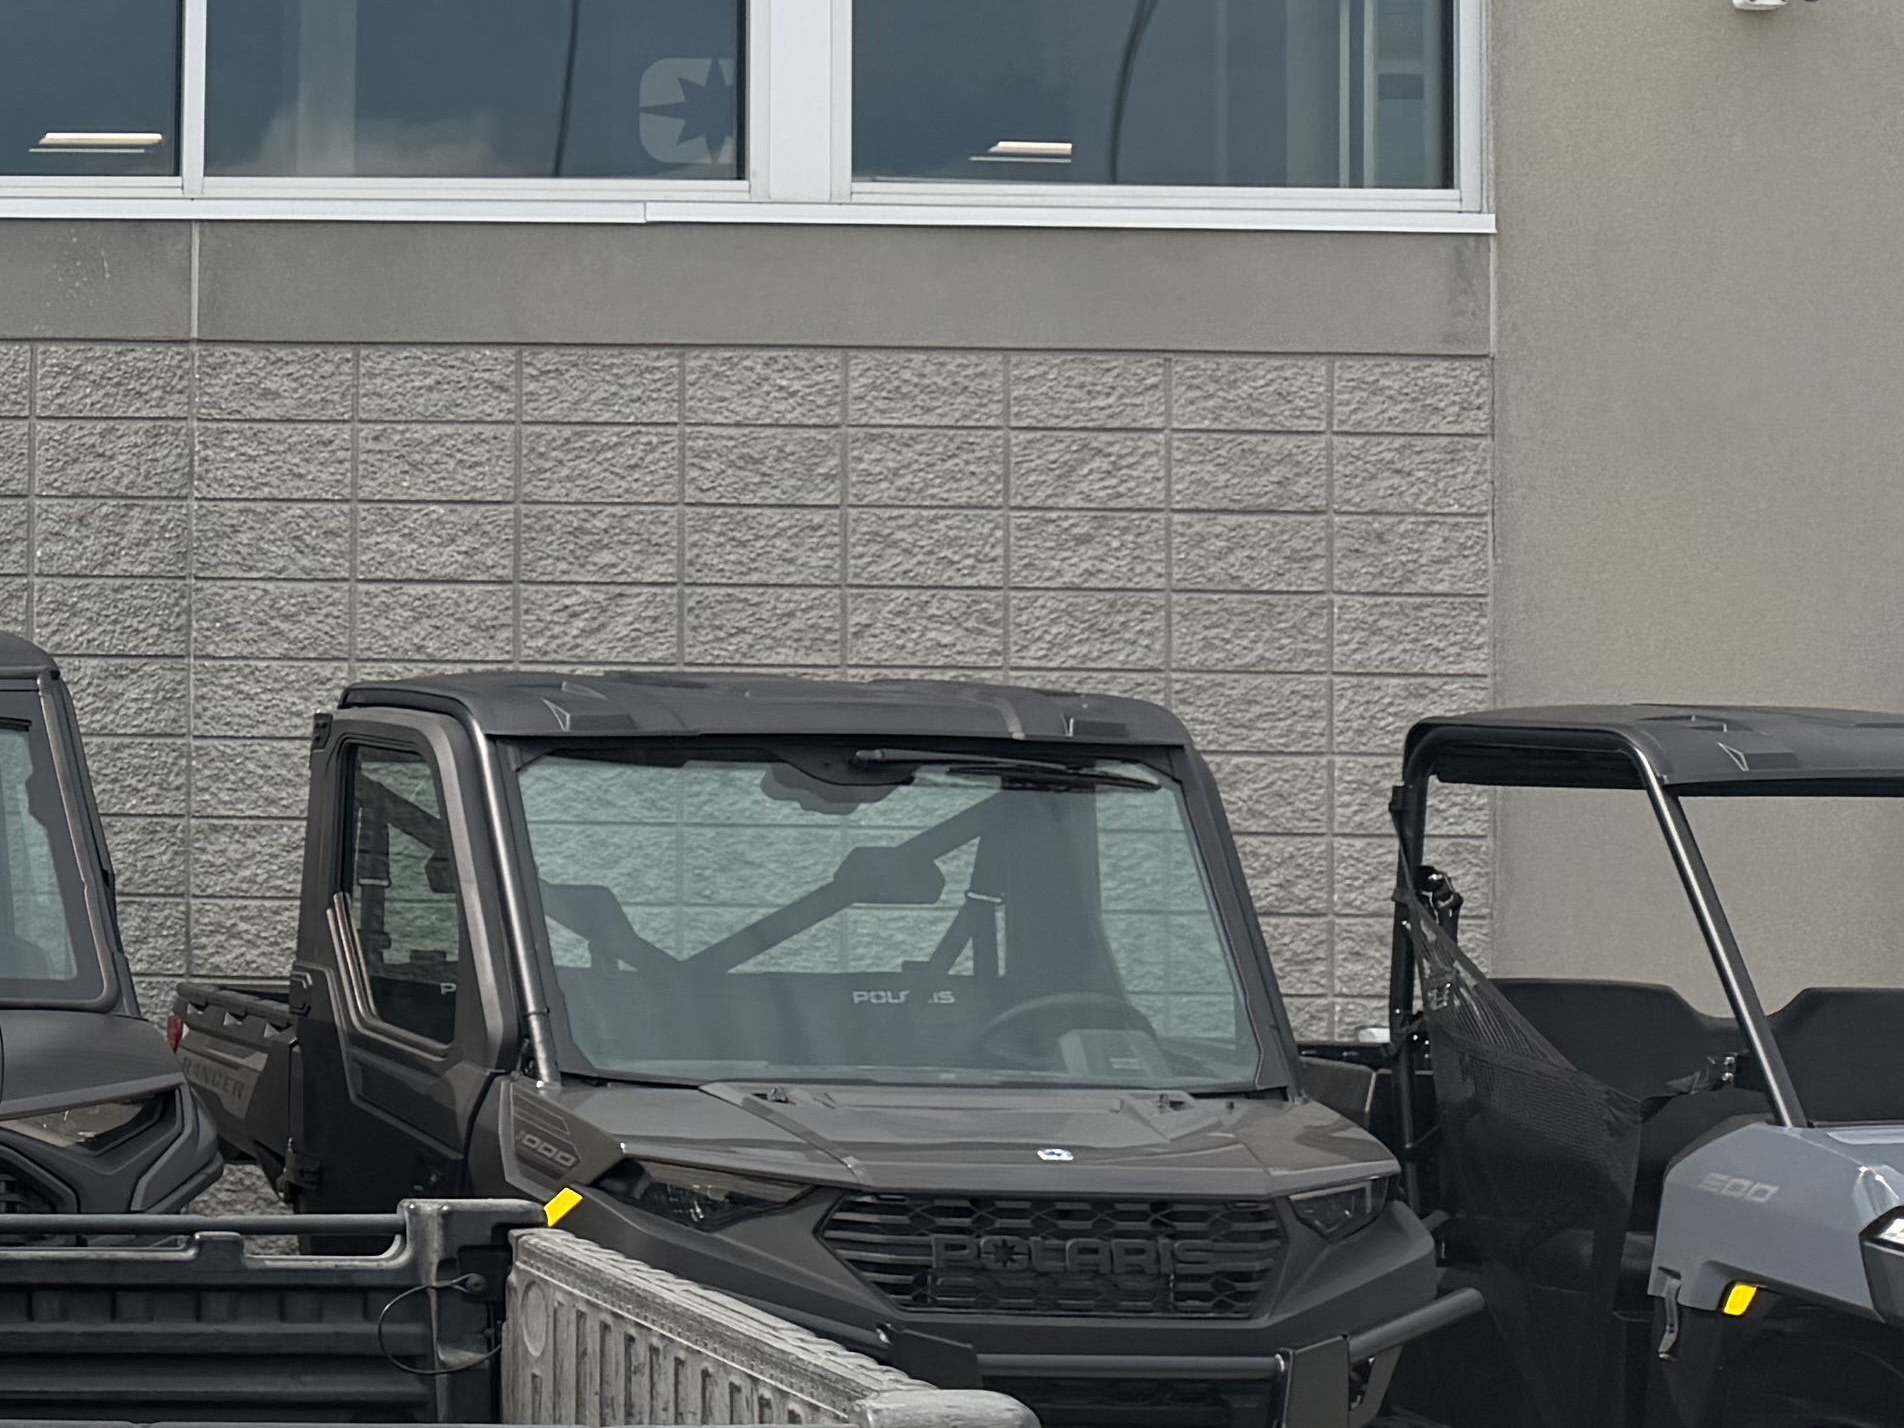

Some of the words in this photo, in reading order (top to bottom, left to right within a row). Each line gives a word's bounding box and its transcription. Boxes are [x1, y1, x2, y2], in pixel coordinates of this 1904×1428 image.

[852, 990, 956, 1004] POLIS
[181, 1056, 245, 1101] RANGER
[515, 1130, 576, 1168] 1000
[1696, 1172, 1781, 1204] 500
[931, 1235, 1226, 1278] POLARIS
